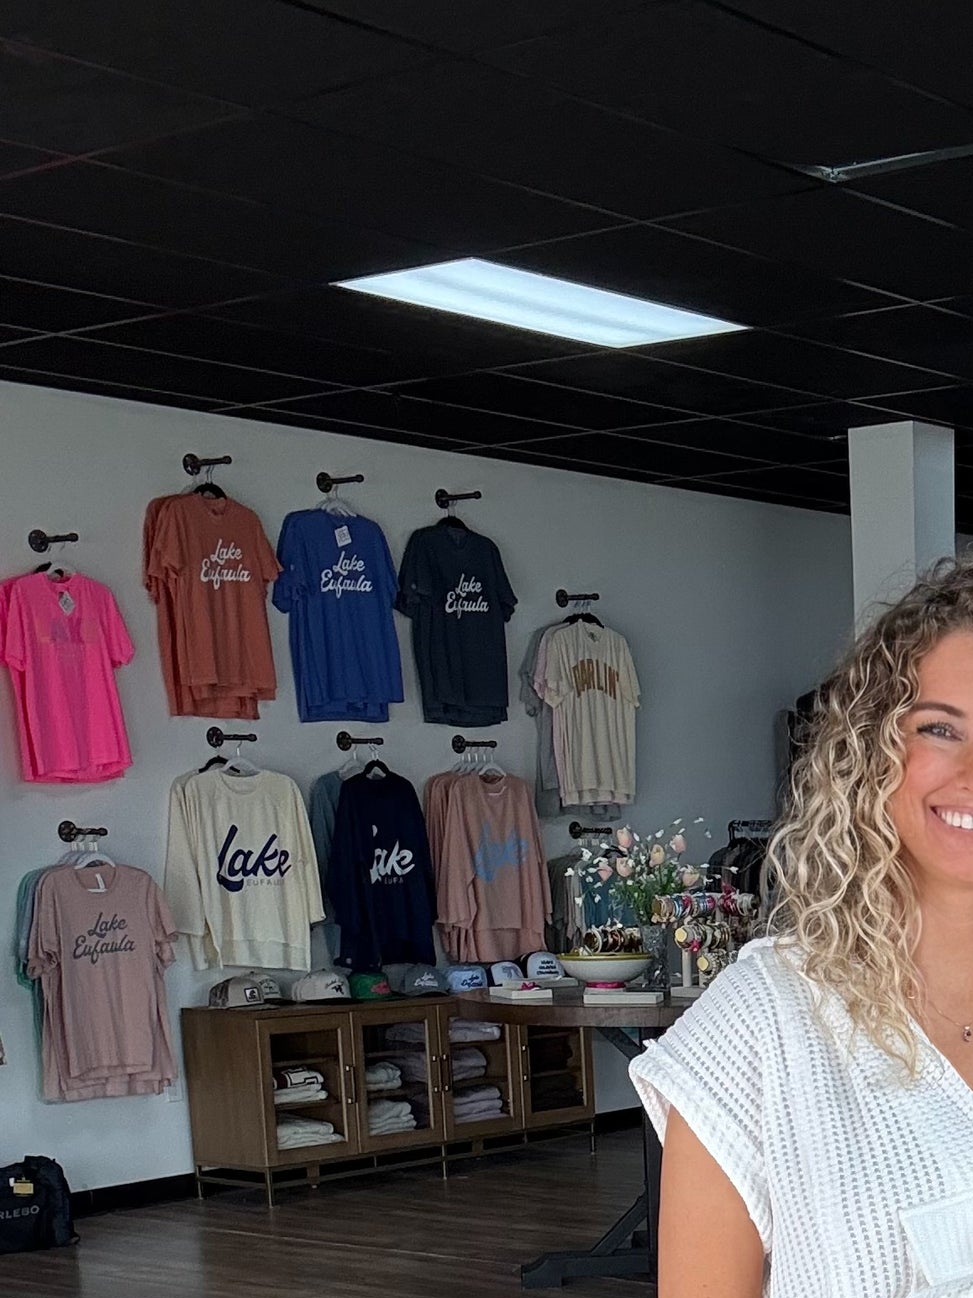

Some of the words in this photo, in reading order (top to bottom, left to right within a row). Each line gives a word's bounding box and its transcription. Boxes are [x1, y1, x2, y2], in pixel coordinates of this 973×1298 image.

[210, 538, 243, 565] Lake
[332, 550, 366, 576] Lake
[200, 558, 251, 590] Eufaula
[320, 569, 373, 599] Eufaula
[455, 573, 483, 597] Lake
[217, 824, 292, 892] Lake
[369, 825, 415, 884] ake
[87, 911, 128, 939] Lake
[73, 934, 136, 965] Eufaula
